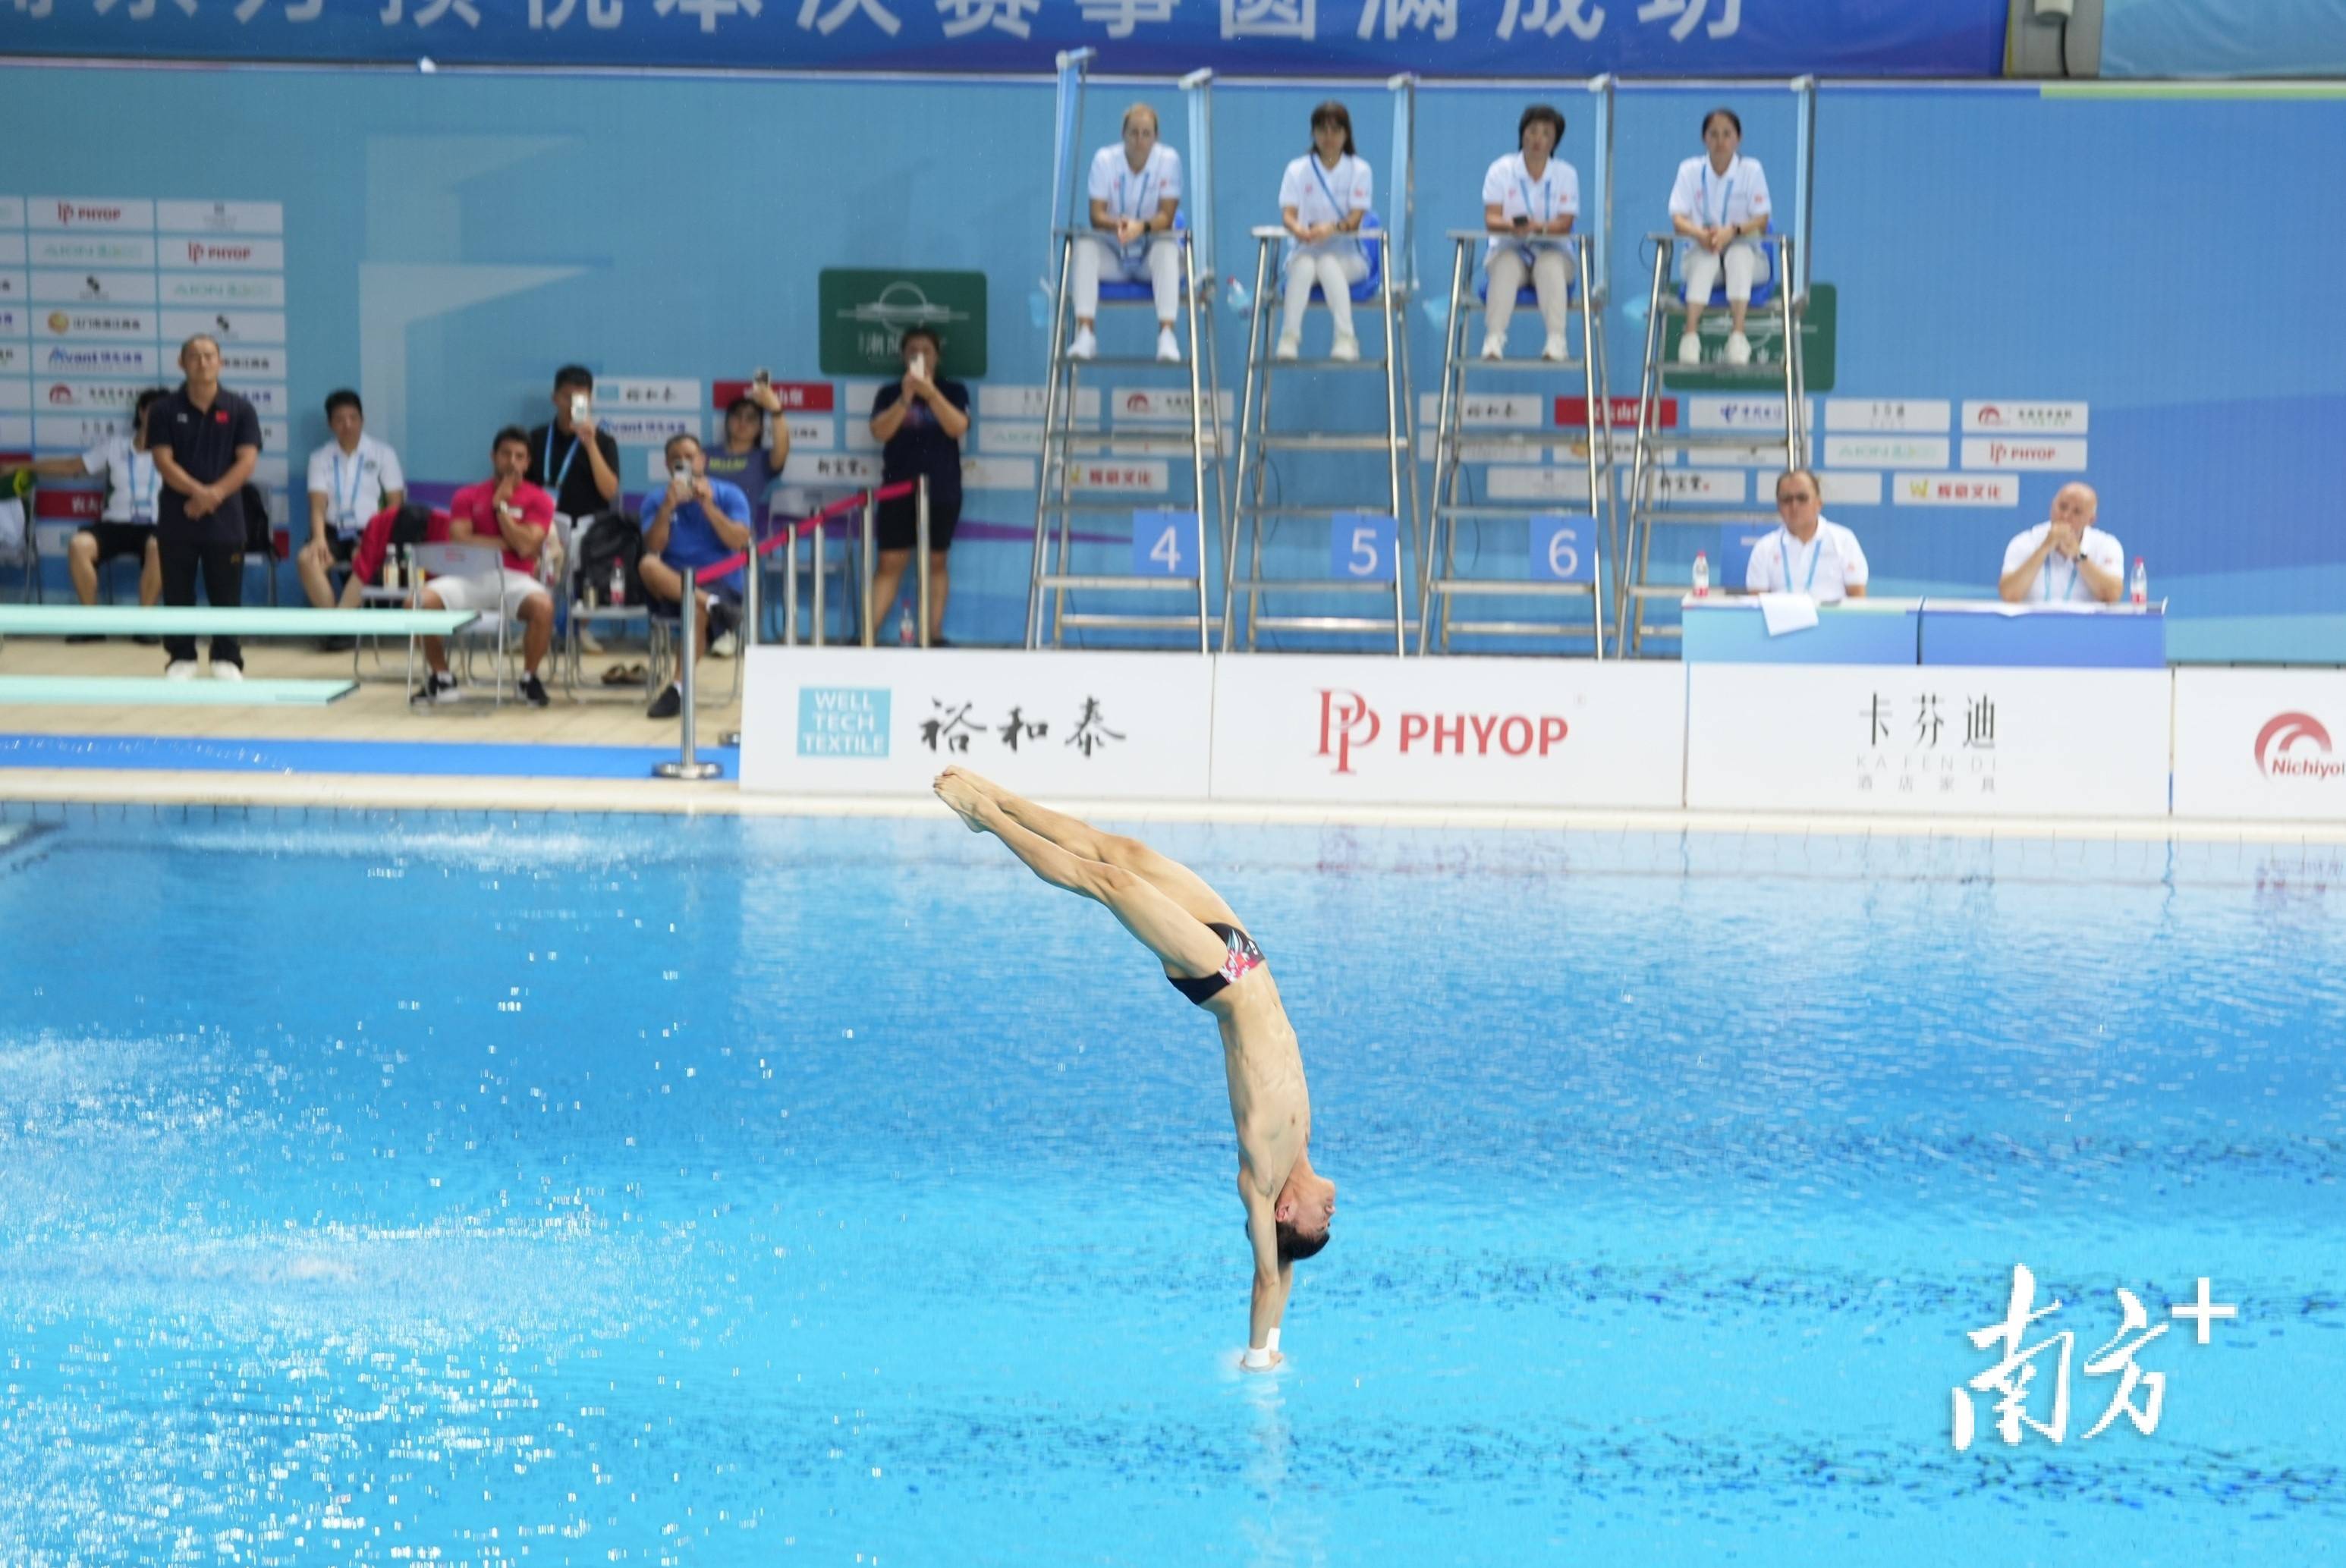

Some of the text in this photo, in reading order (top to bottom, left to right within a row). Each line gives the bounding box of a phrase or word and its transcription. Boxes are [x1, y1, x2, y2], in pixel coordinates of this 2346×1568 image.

[1149, 525, 1181, 573] 4
[1348, 528, 1379, 577] 5
[1547, 529, 1579, 577] 6
[812, 712, 875, 733] TECH
[814, 690, 873, 711] WELL
[1858, 691, 1997, 750] 卡芬迪
[802, 732, 884, 753] TEXTILE
[919, 694, 1127, 759] 裕和泰
[1398, 712, 1570, 758] PHYOP
